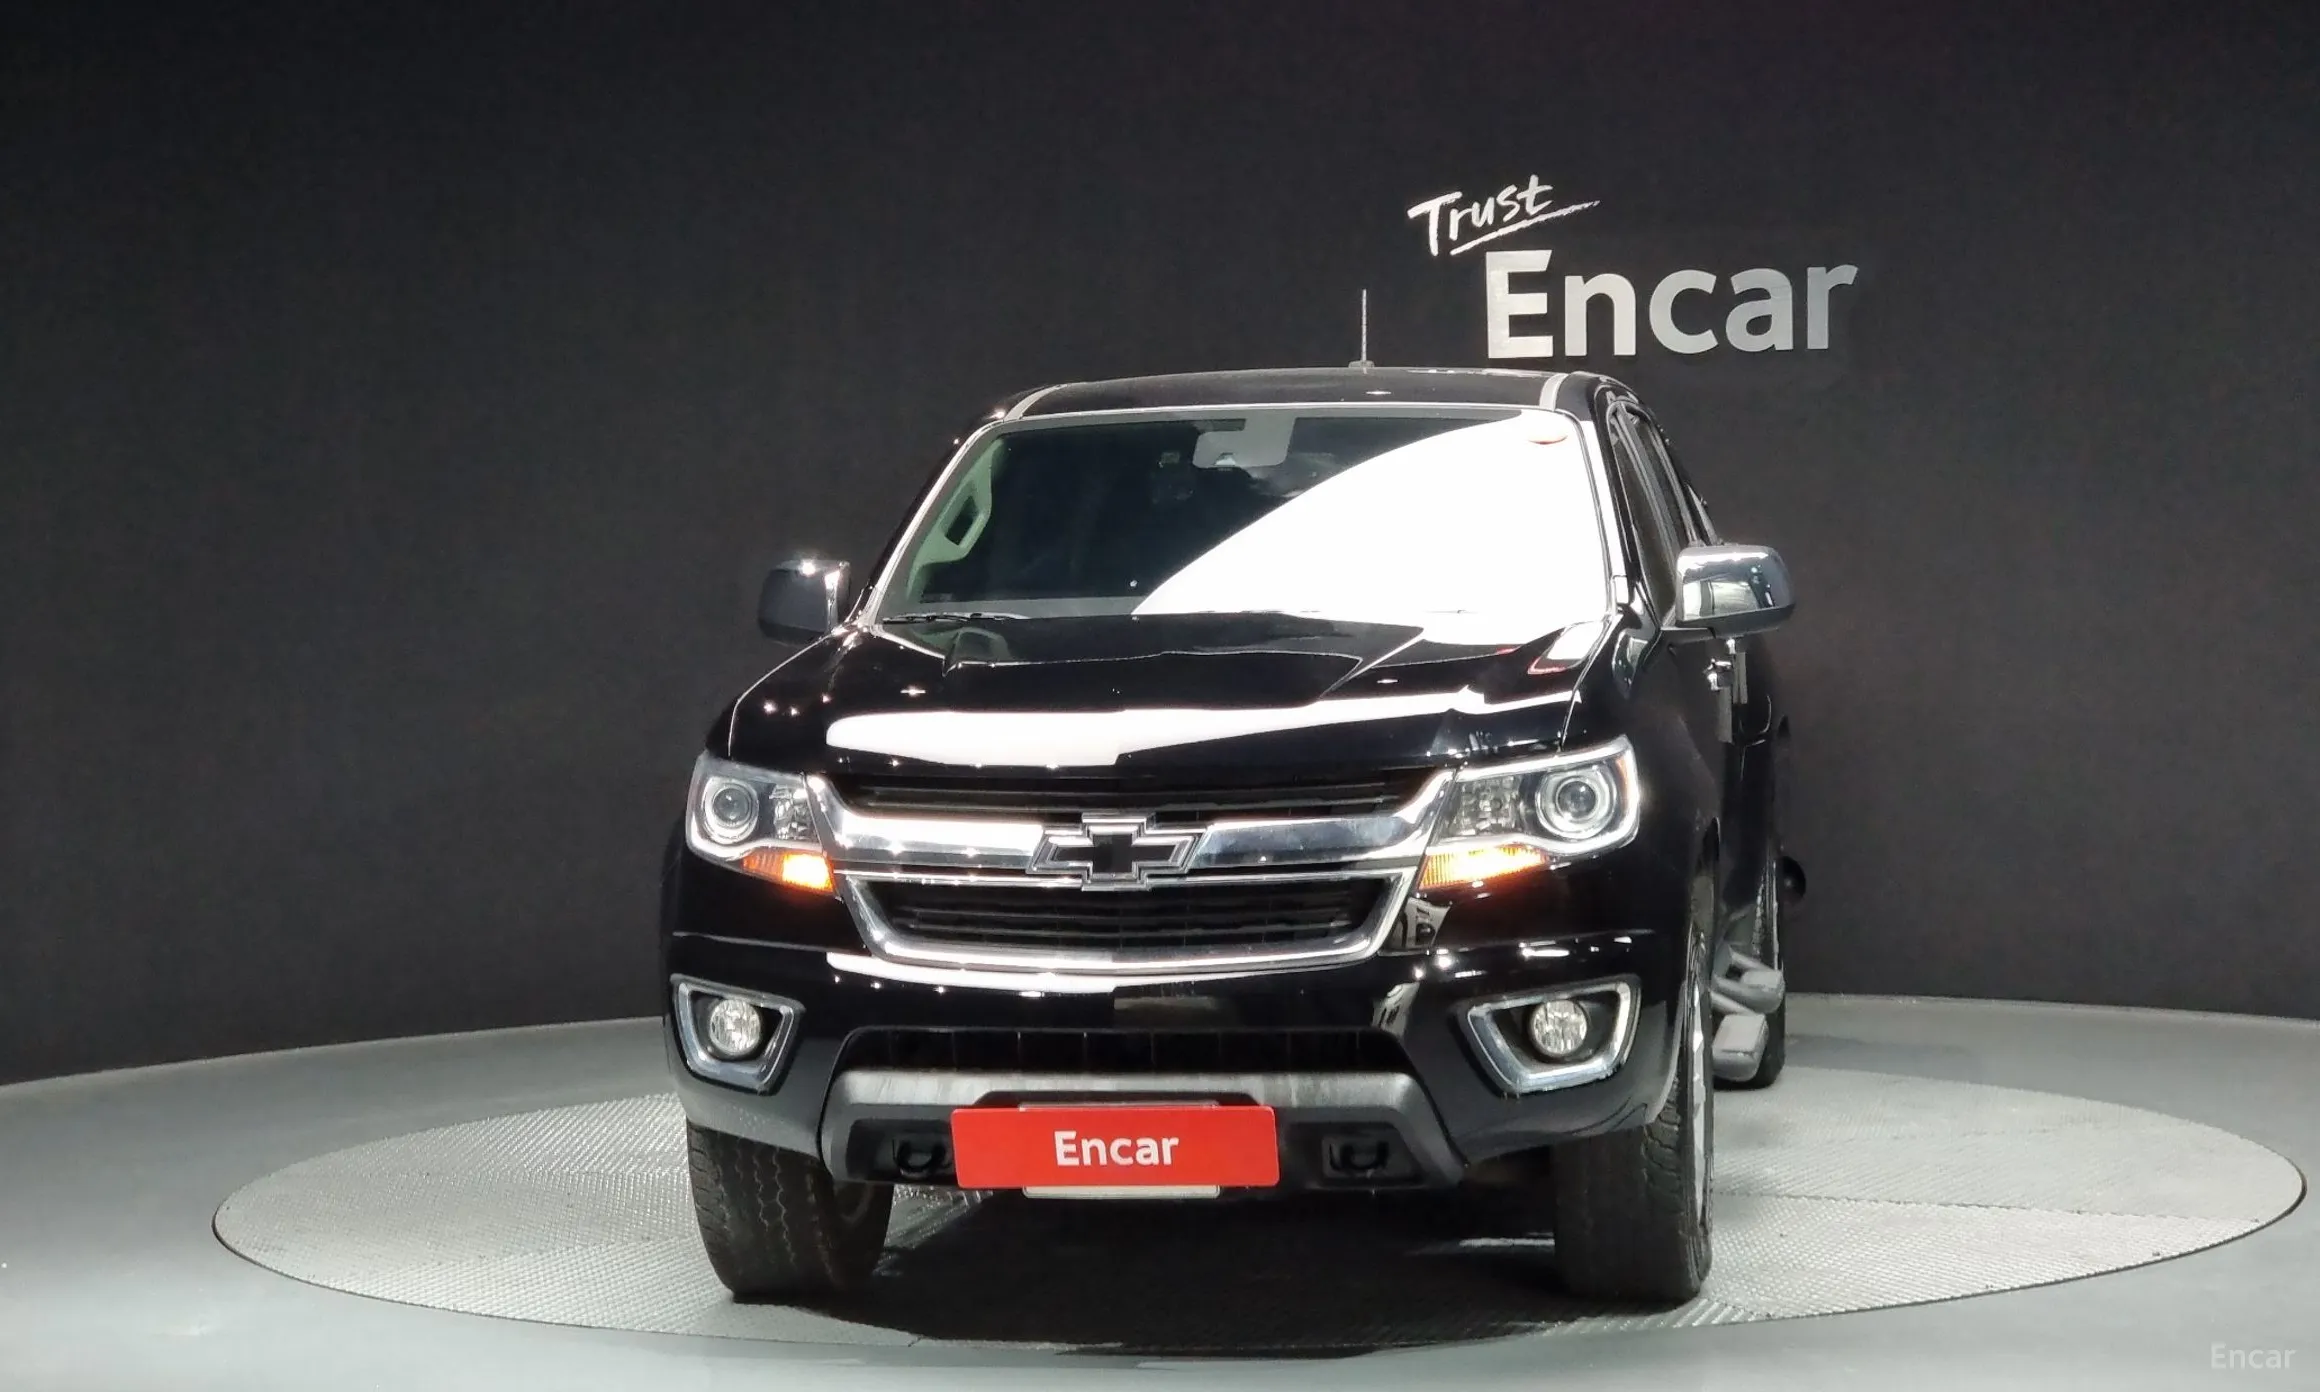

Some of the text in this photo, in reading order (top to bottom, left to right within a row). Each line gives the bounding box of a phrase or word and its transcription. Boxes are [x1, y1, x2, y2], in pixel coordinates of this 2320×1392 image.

[1408, 174, 1554, 256] Trust
[1486, 249, 1859, 359] Encar
[1054, 1130, 1179, 1166] Encar
